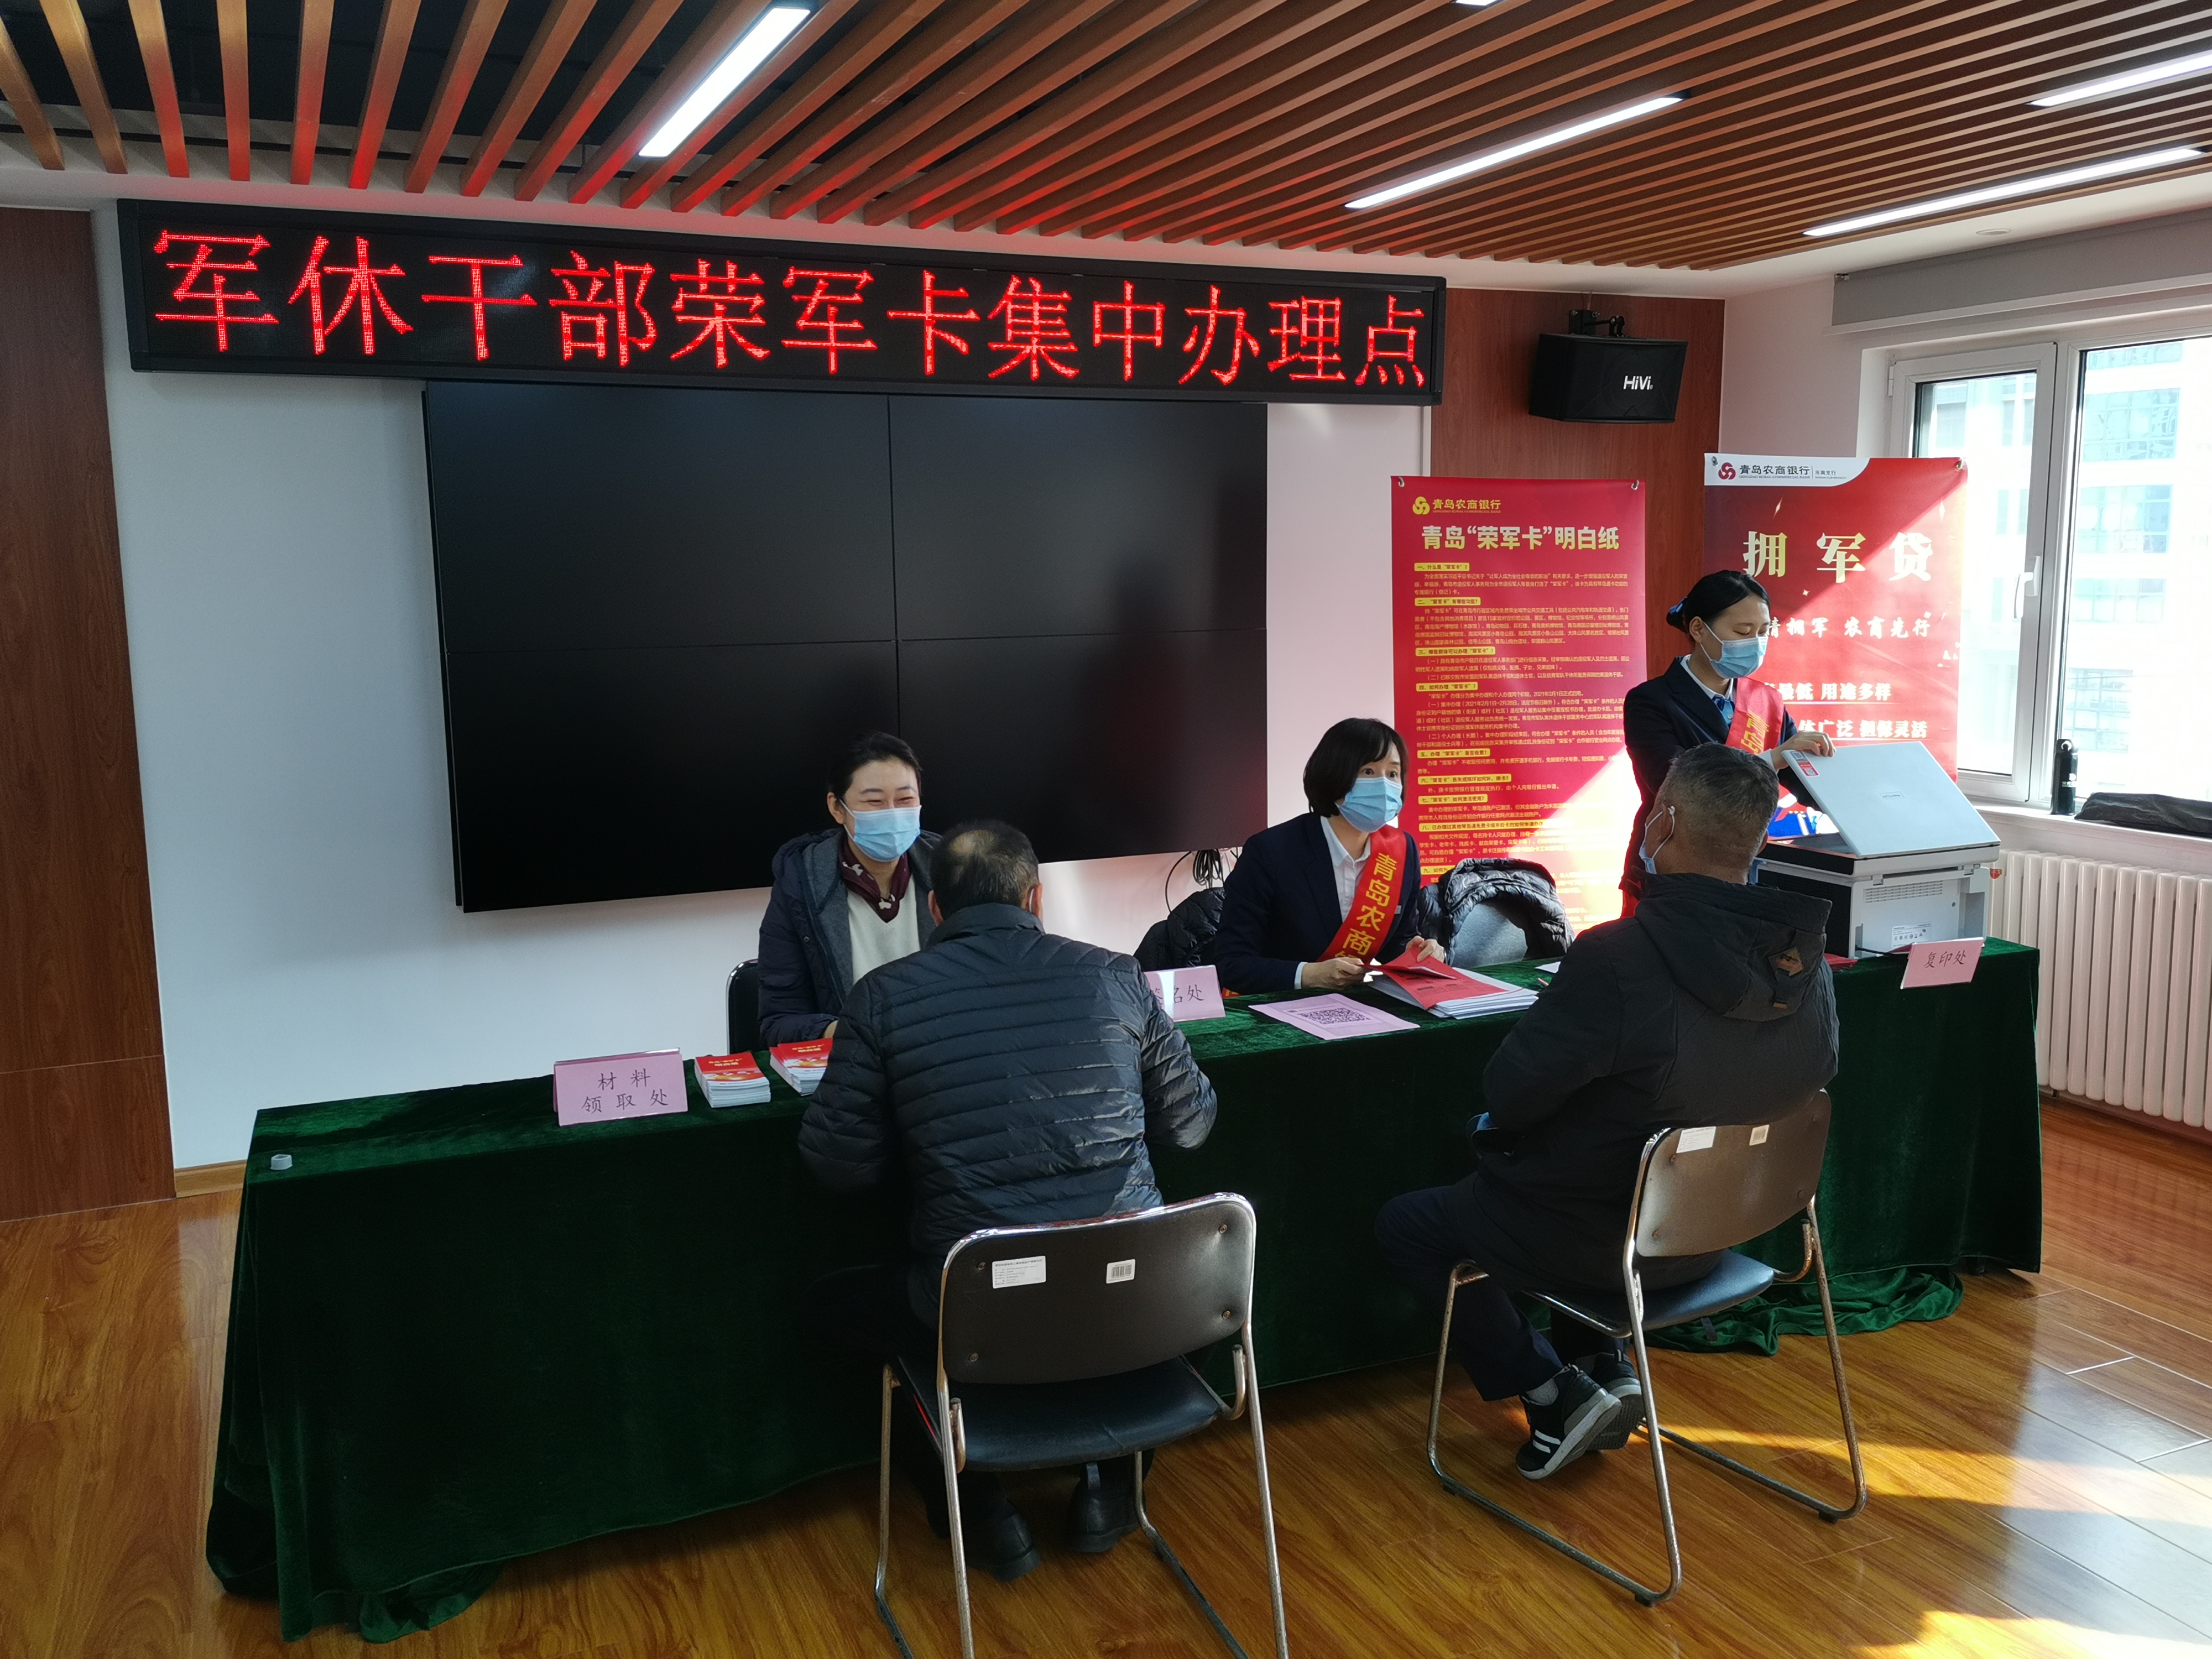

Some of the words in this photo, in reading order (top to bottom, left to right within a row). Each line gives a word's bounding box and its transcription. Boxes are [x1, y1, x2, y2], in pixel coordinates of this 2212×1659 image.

[154, 230, 1425, 387] 军休干部荣军卡集中办理点
[1739, 465, 1810, 475] 青岛农商银行
[1432, 499, 1501, 510] 青岛农商银行
[1421, 525, 1619, 550] 青岛“荣军卡”明白纸
[1743, 531, 1933, 583] 拥军贷
[1764, 682, 1814, 700] 最低
[1820, 682, 1892, 701] 用途多样
[1859, 719, 1928, 738] 担保灵活
[1422, 821, 1543, 830] 八、已办理过其他琴岛通免费卡或半价卡的如何申请办
[1334, 853, 1397, 959] 青岛农商
[1924, 950, 1966, 968] 复印处
[597, 1068, 651, 1091] 材料
[581, 1088, 669, 1114] 领取处
